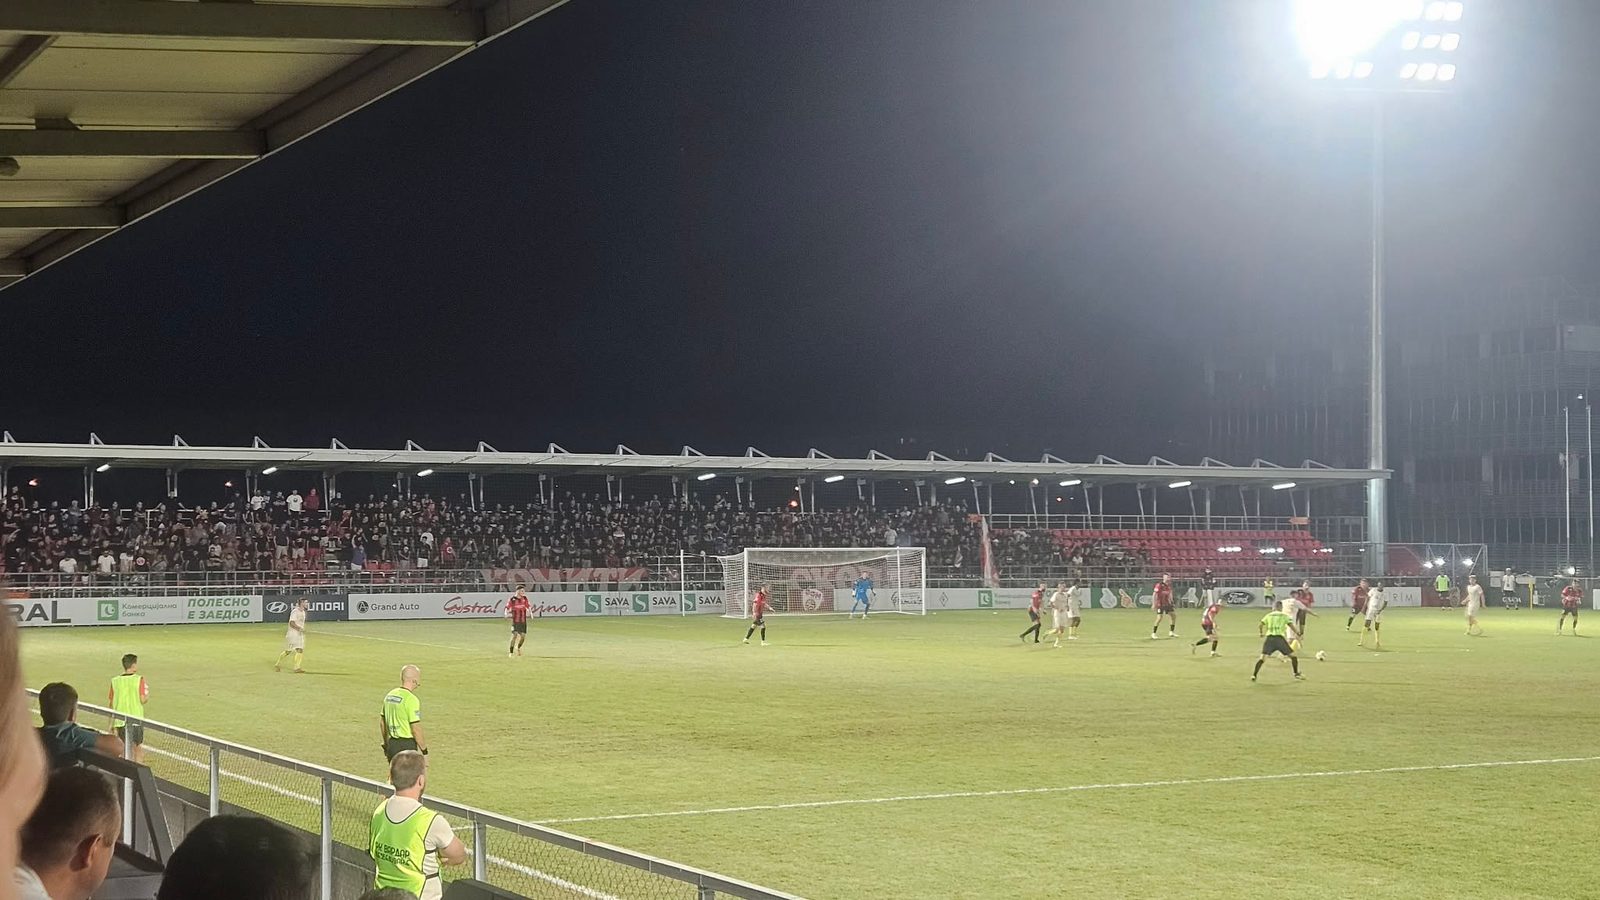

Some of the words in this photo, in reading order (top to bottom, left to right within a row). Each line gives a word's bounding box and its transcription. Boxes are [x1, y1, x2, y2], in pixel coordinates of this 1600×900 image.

[187, 597, 250, 607] ПОЛЕСНО
[605, 597, 629, 606] SAVA
[652, 597, 677, 606] SAVA
[698, 596, 722, 605] SAVA
[1227, 592, 1248, 603] Ford
[291, 602, 344, 611] HUNDAI
[371, 603, 397, 611] Grand
[399, 602, 420, 610] Auto
[187, 611, 195, 619] Е
[199, 610, 250, 620] ЗАЕДНО
